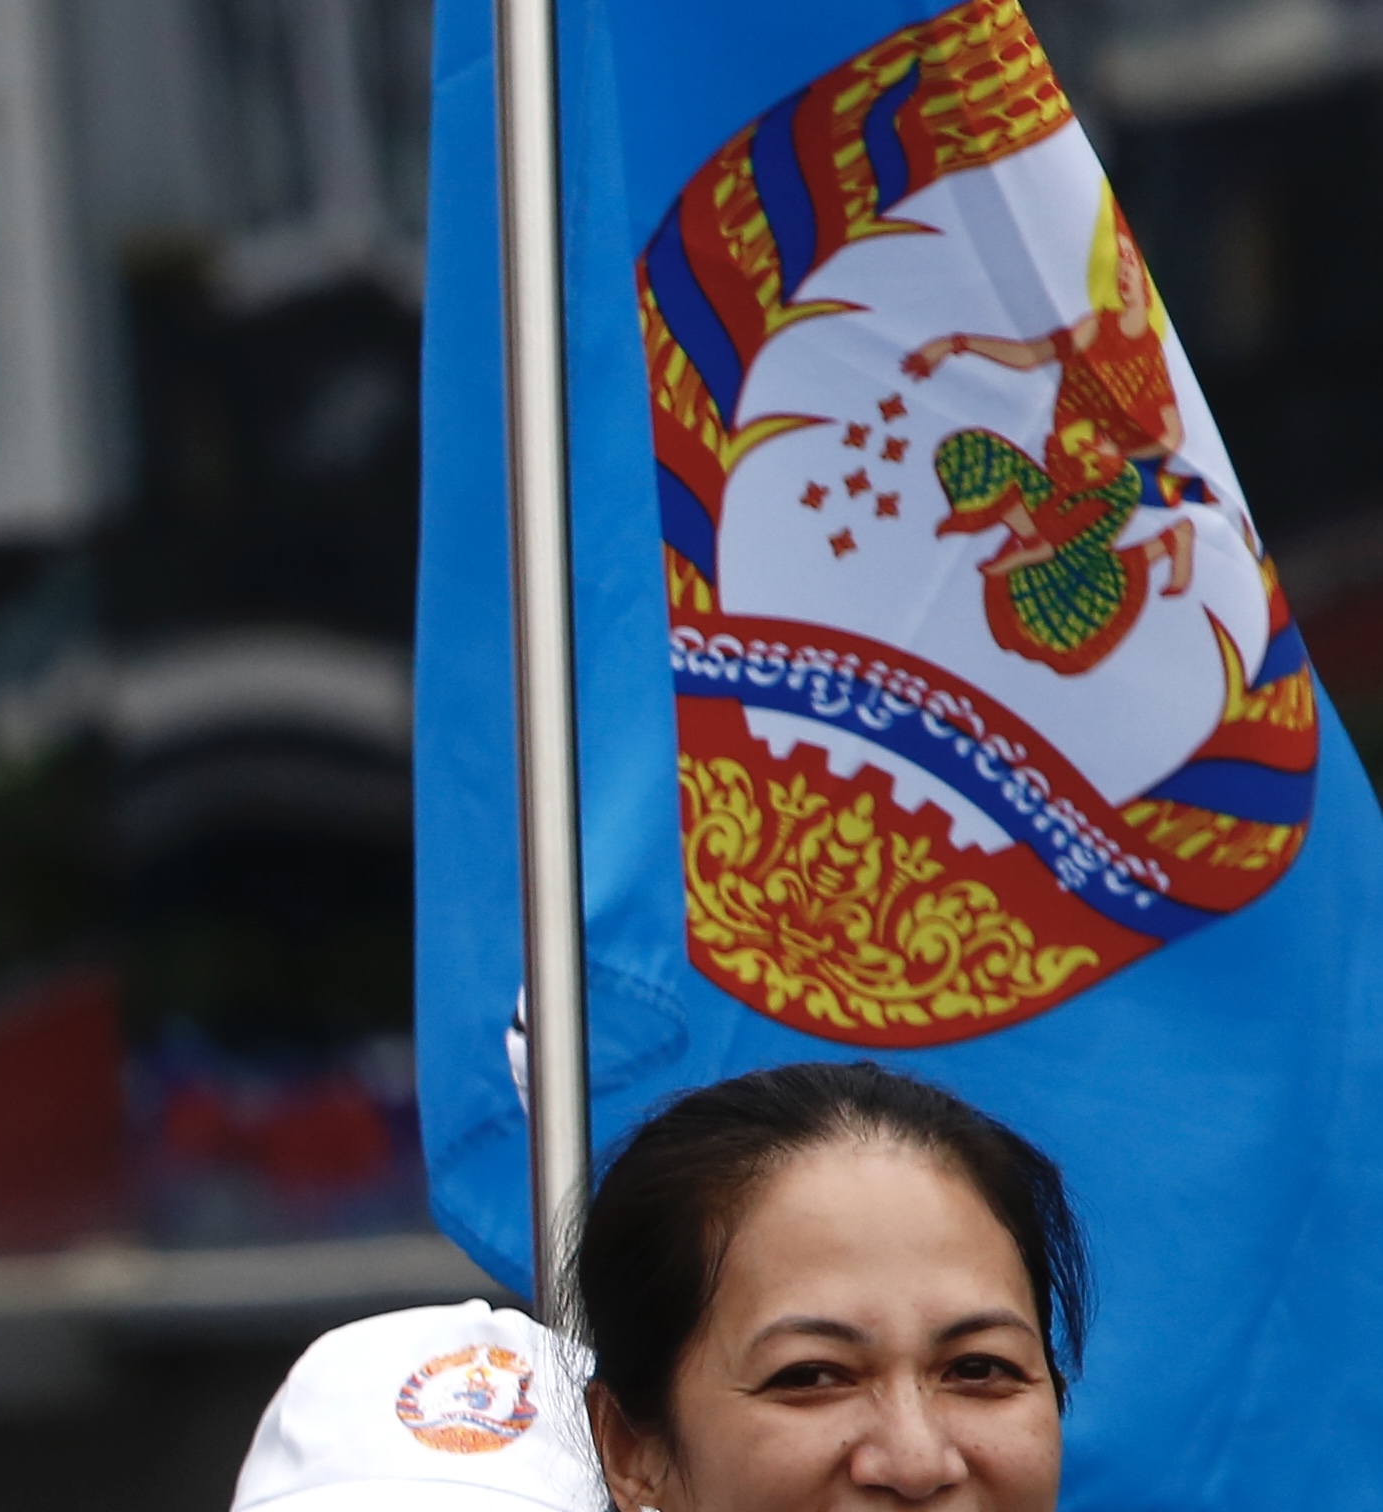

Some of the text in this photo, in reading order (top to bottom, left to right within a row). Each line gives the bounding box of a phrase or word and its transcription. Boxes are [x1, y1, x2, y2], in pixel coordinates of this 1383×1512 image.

[670, 626, 1170, 909] ណបក្សប្រជាជនកម្ពុជា
